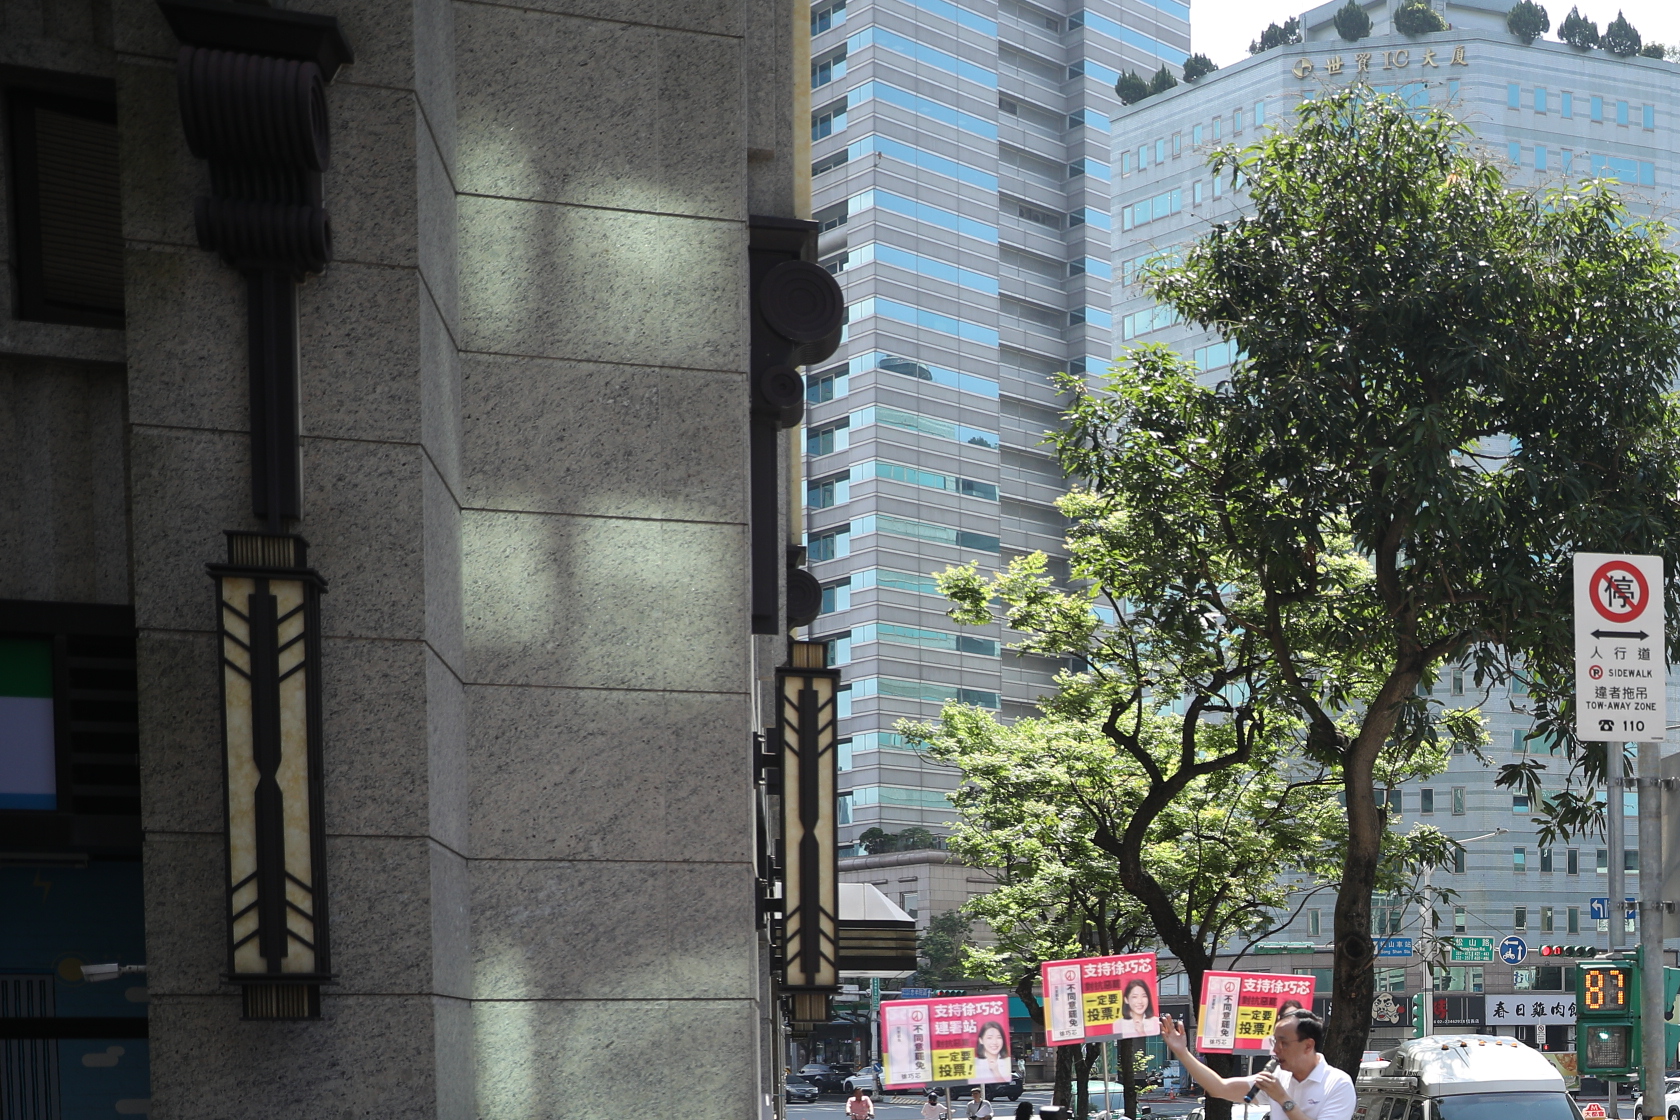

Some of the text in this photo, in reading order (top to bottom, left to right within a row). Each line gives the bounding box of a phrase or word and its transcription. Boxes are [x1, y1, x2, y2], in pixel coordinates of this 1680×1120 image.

[1324, 45, 1468, 75] 世貿IC大廈
[1590, 646, 1651, 661] 人行道
[1608, 668, 1653, 678] SIDEWALK
[1595, 686, 1648, 700] 違者拖吊
[1586, 701, 1657, 711] TOW-AWAY ZONE
[1623, 720, 1645, 732] 110
[1455, 938, 1490, 947] 松山路
[1083, 957, 1153, 979] 支持徐巧芯
[1243, 978, 1311, 995] 支持徐巧芯
[1585, 969, 1625, 1010] 87
[1066, 983, 1079, 1028] 不同意罷免
[1086, 993, 1119, 1007] 一定要
[934, 1000, 1004, 1018] 支持徐巧芯
[1087, 1006, 1121, 1023] 投票!
[1220, 994, 1233, 1037] 不同意罷免
[1240, 1009, 1273, 1022] 一定要
[934, 1019, 977, 1036] 連署站
[1239, 1021, 1273, 1036] 投票!
[913, 1024, 926, 1071] 不同意罷免
[938, 1050, 972, 1062] 一定要
[938, 1063, 974, 1079] 投票!
